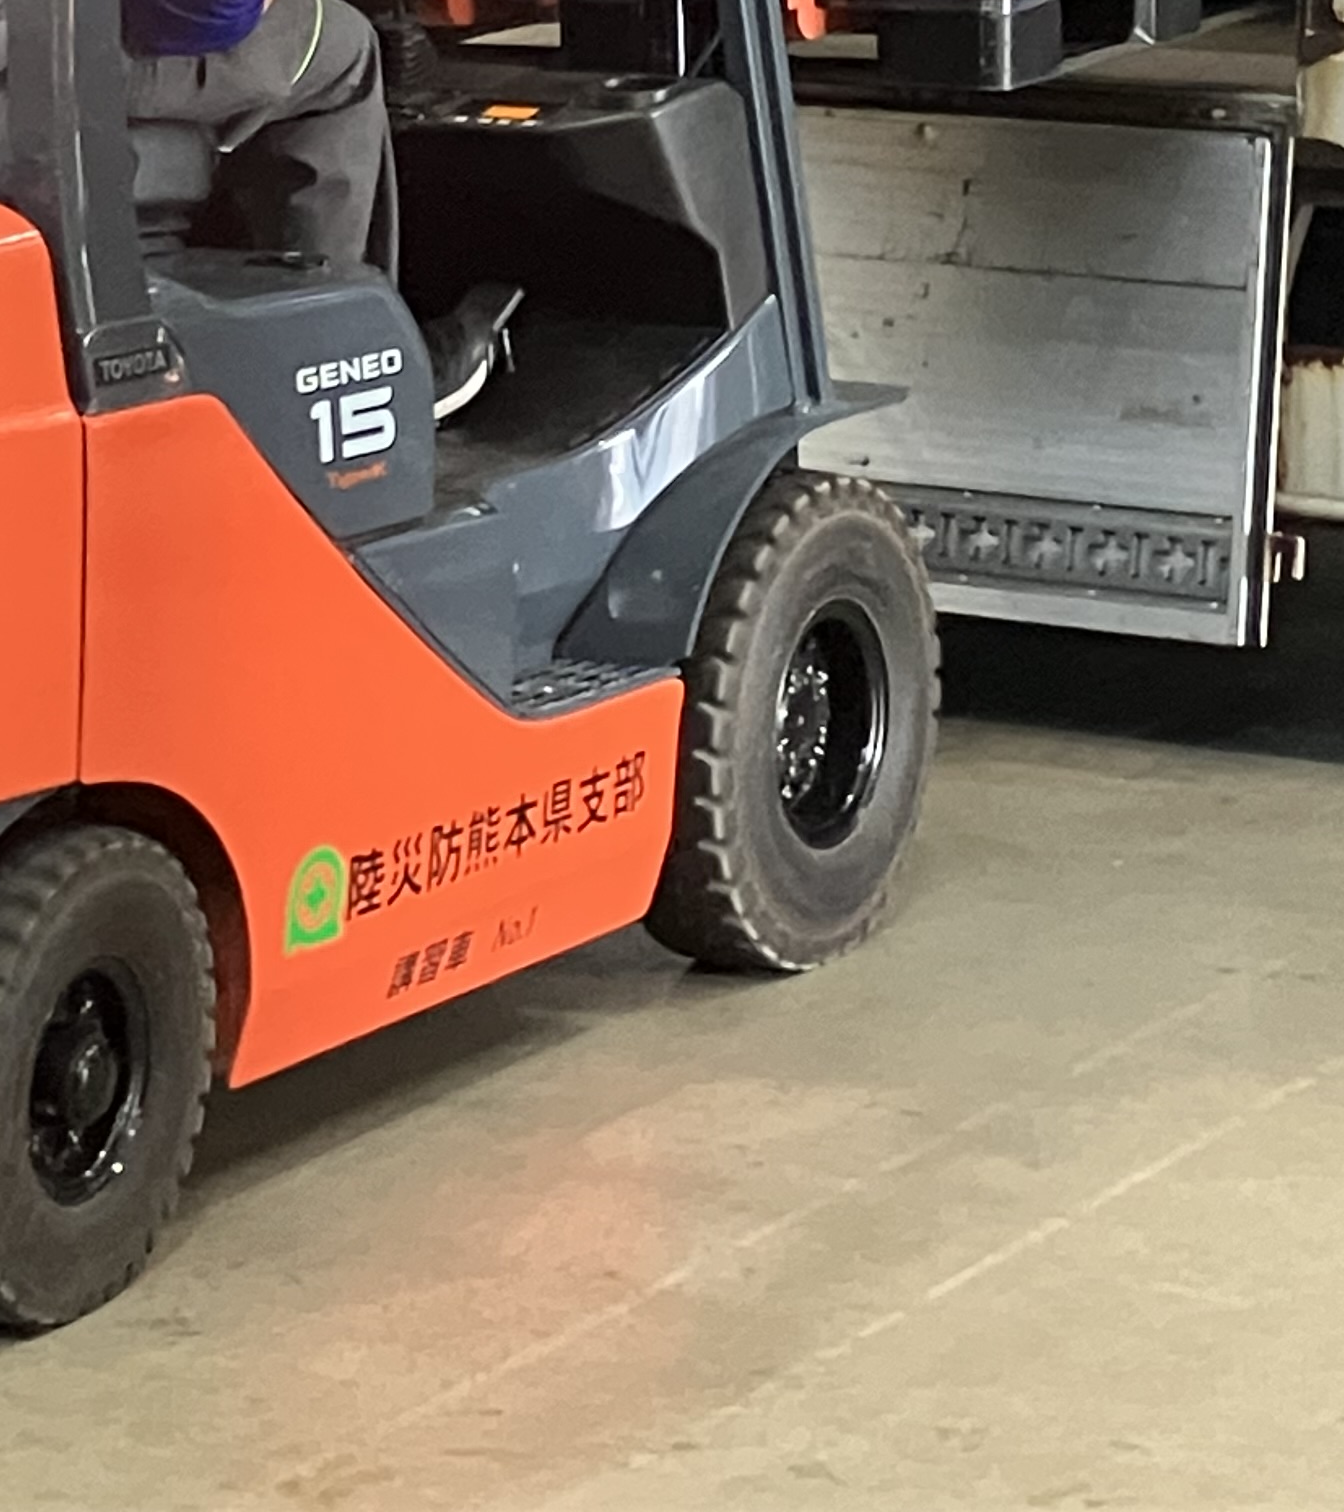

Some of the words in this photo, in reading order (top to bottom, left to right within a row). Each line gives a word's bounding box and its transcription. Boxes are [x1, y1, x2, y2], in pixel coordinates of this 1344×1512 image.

[98, 349, 167, 382] TOYOTA
[296, 348, 402, 394] GENEO
[310, 386, 396, 464] 15
[346, 750, 646, 921] 陸災防熊本県支部
